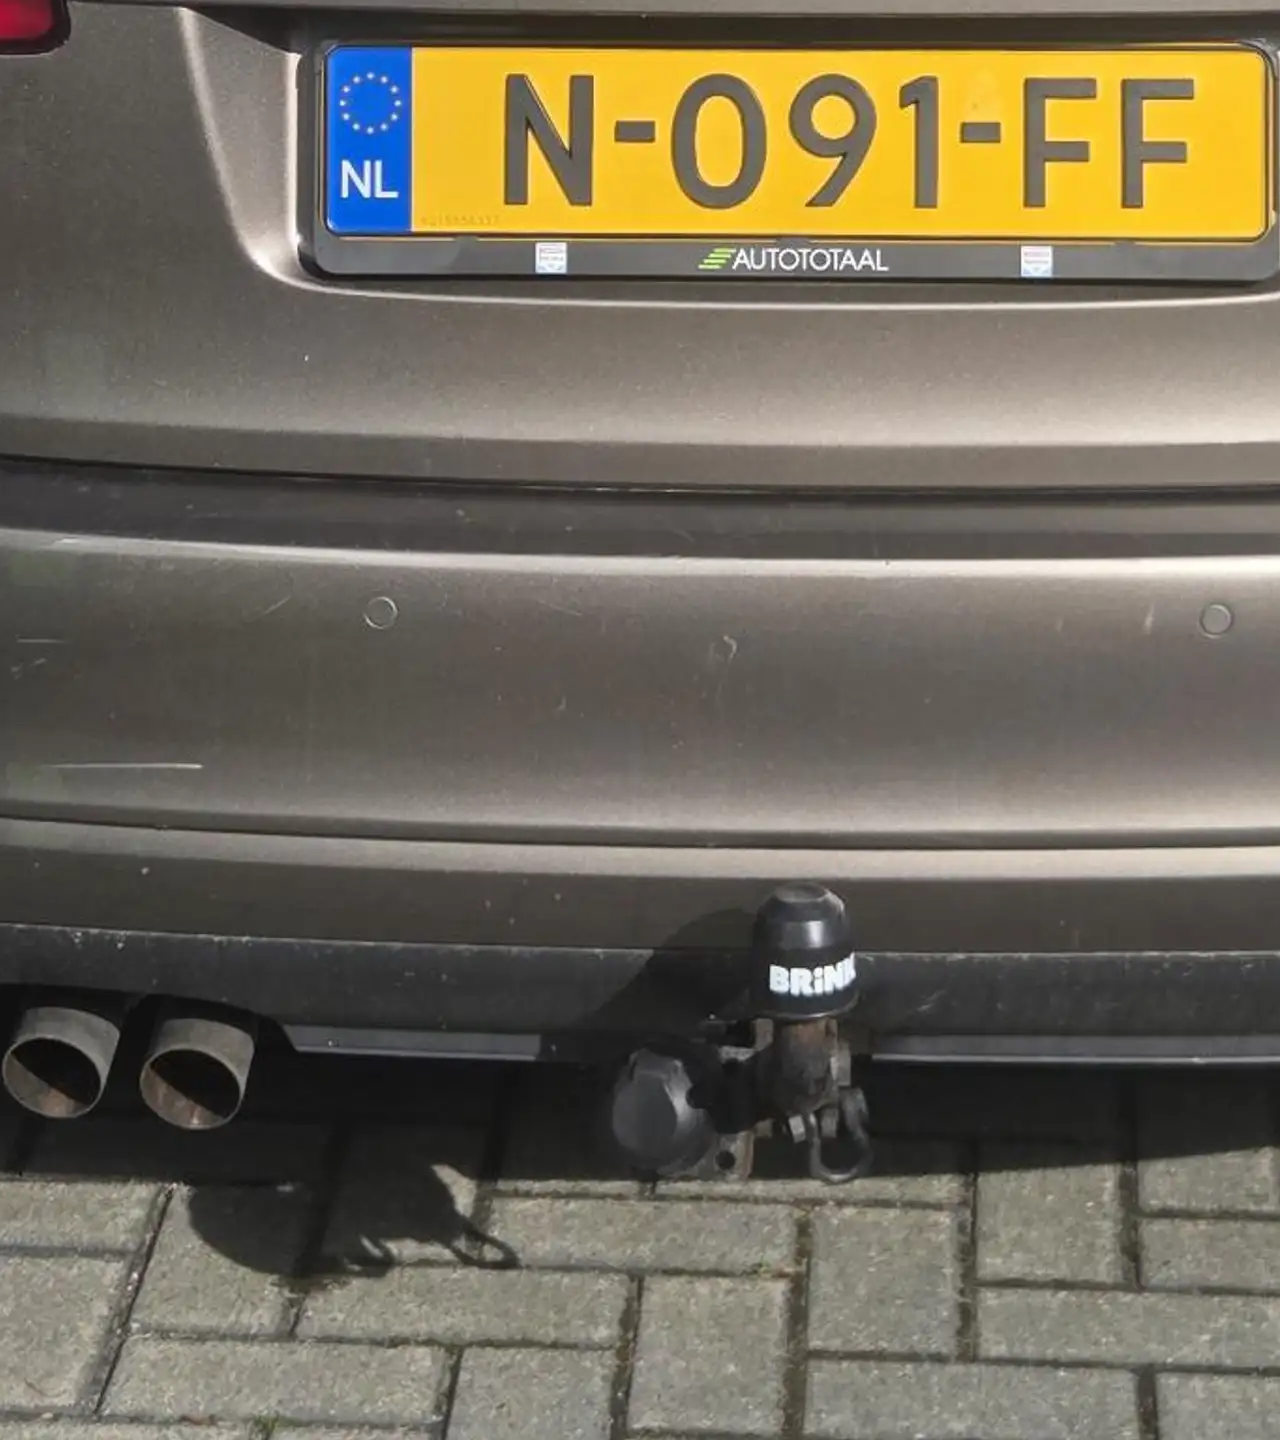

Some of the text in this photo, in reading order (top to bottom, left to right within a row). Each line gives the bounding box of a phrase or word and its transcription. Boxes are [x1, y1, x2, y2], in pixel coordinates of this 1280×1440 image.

[503, 72, 1195, 210] N-091-FF
[340, 160, 400, 199] NL
[732, 248, 890, 272] AUTOTOTAAL
